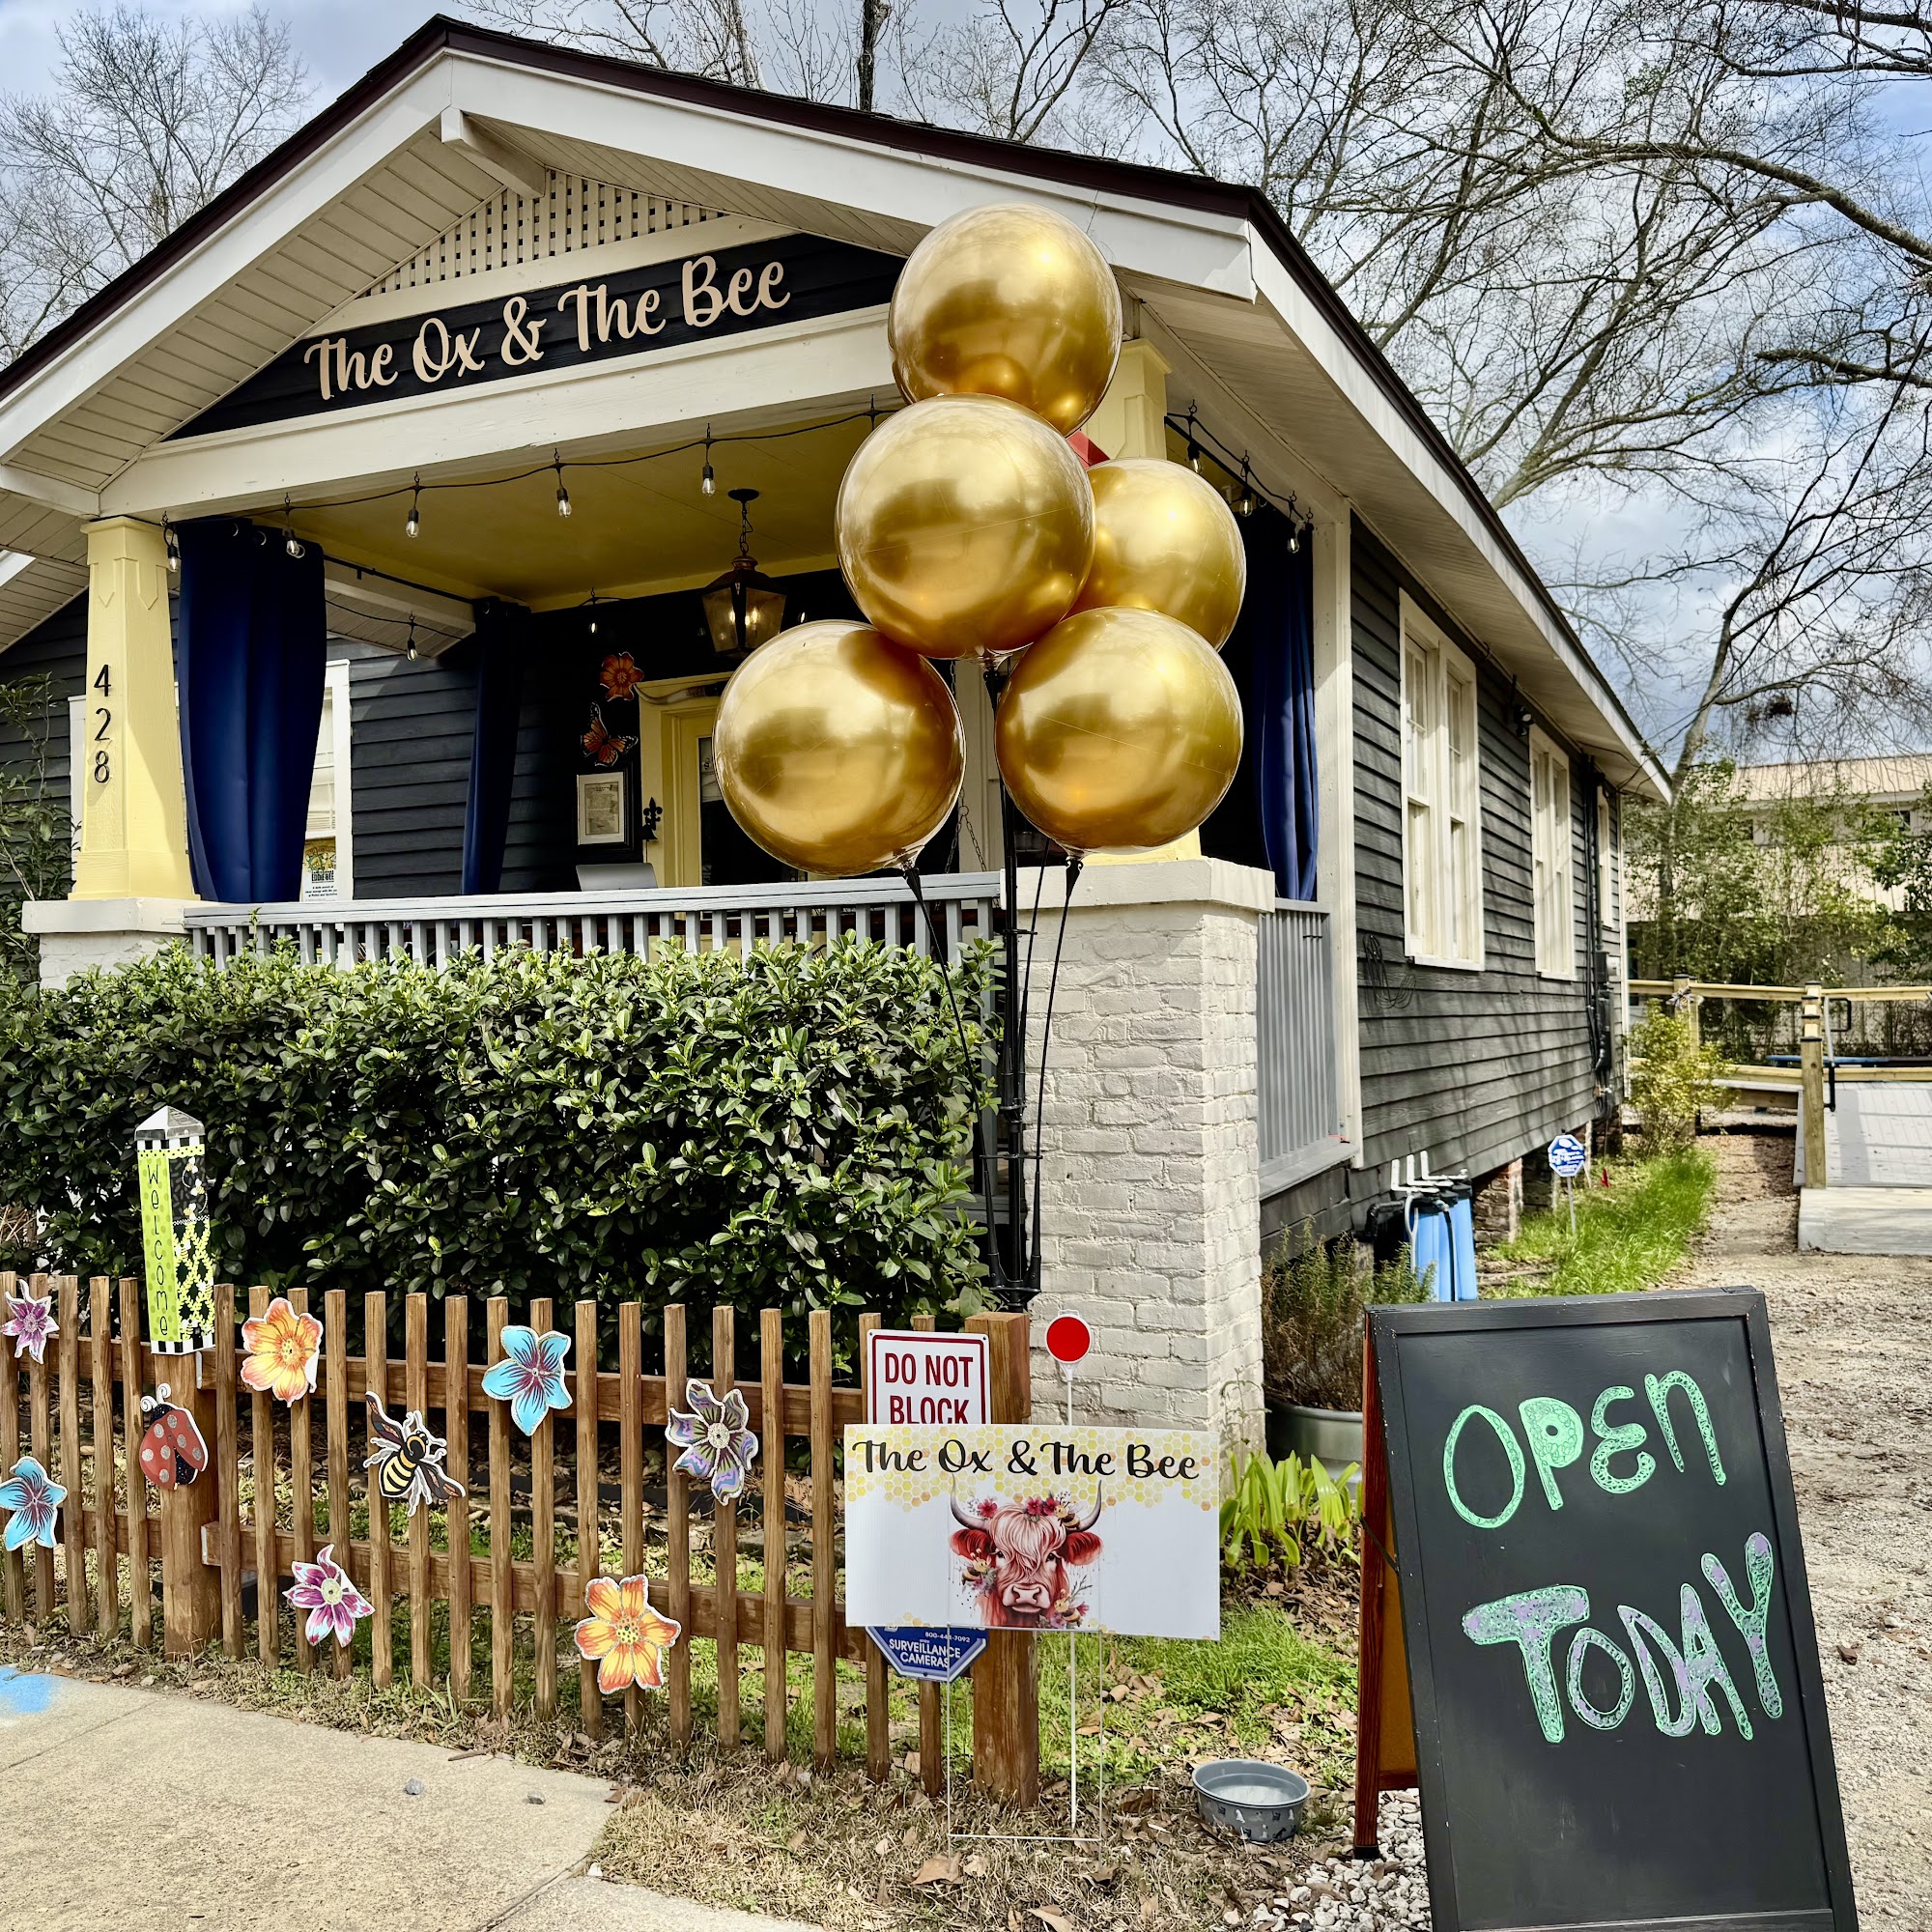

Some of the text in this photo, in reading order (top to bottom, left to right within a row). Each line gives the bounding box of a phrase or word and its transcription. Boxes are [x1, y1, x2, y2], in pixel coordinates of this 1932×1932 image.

[304, 255, 790, 401] The Ox & The Bee
[94, 664, 112, 783] 428
[885, 1352, 974, 1387] DO NOT
[890, 1395, 970, 1424] BLOCK
[852, 1439, 1200, 1480] The Ox & The Bee
[889, 1638, 961, 1659] SURVEILLANCE
[1462, 1532, 1783, 1744] TODAY
[899, 1651, 950, 1668] CAMERAS
